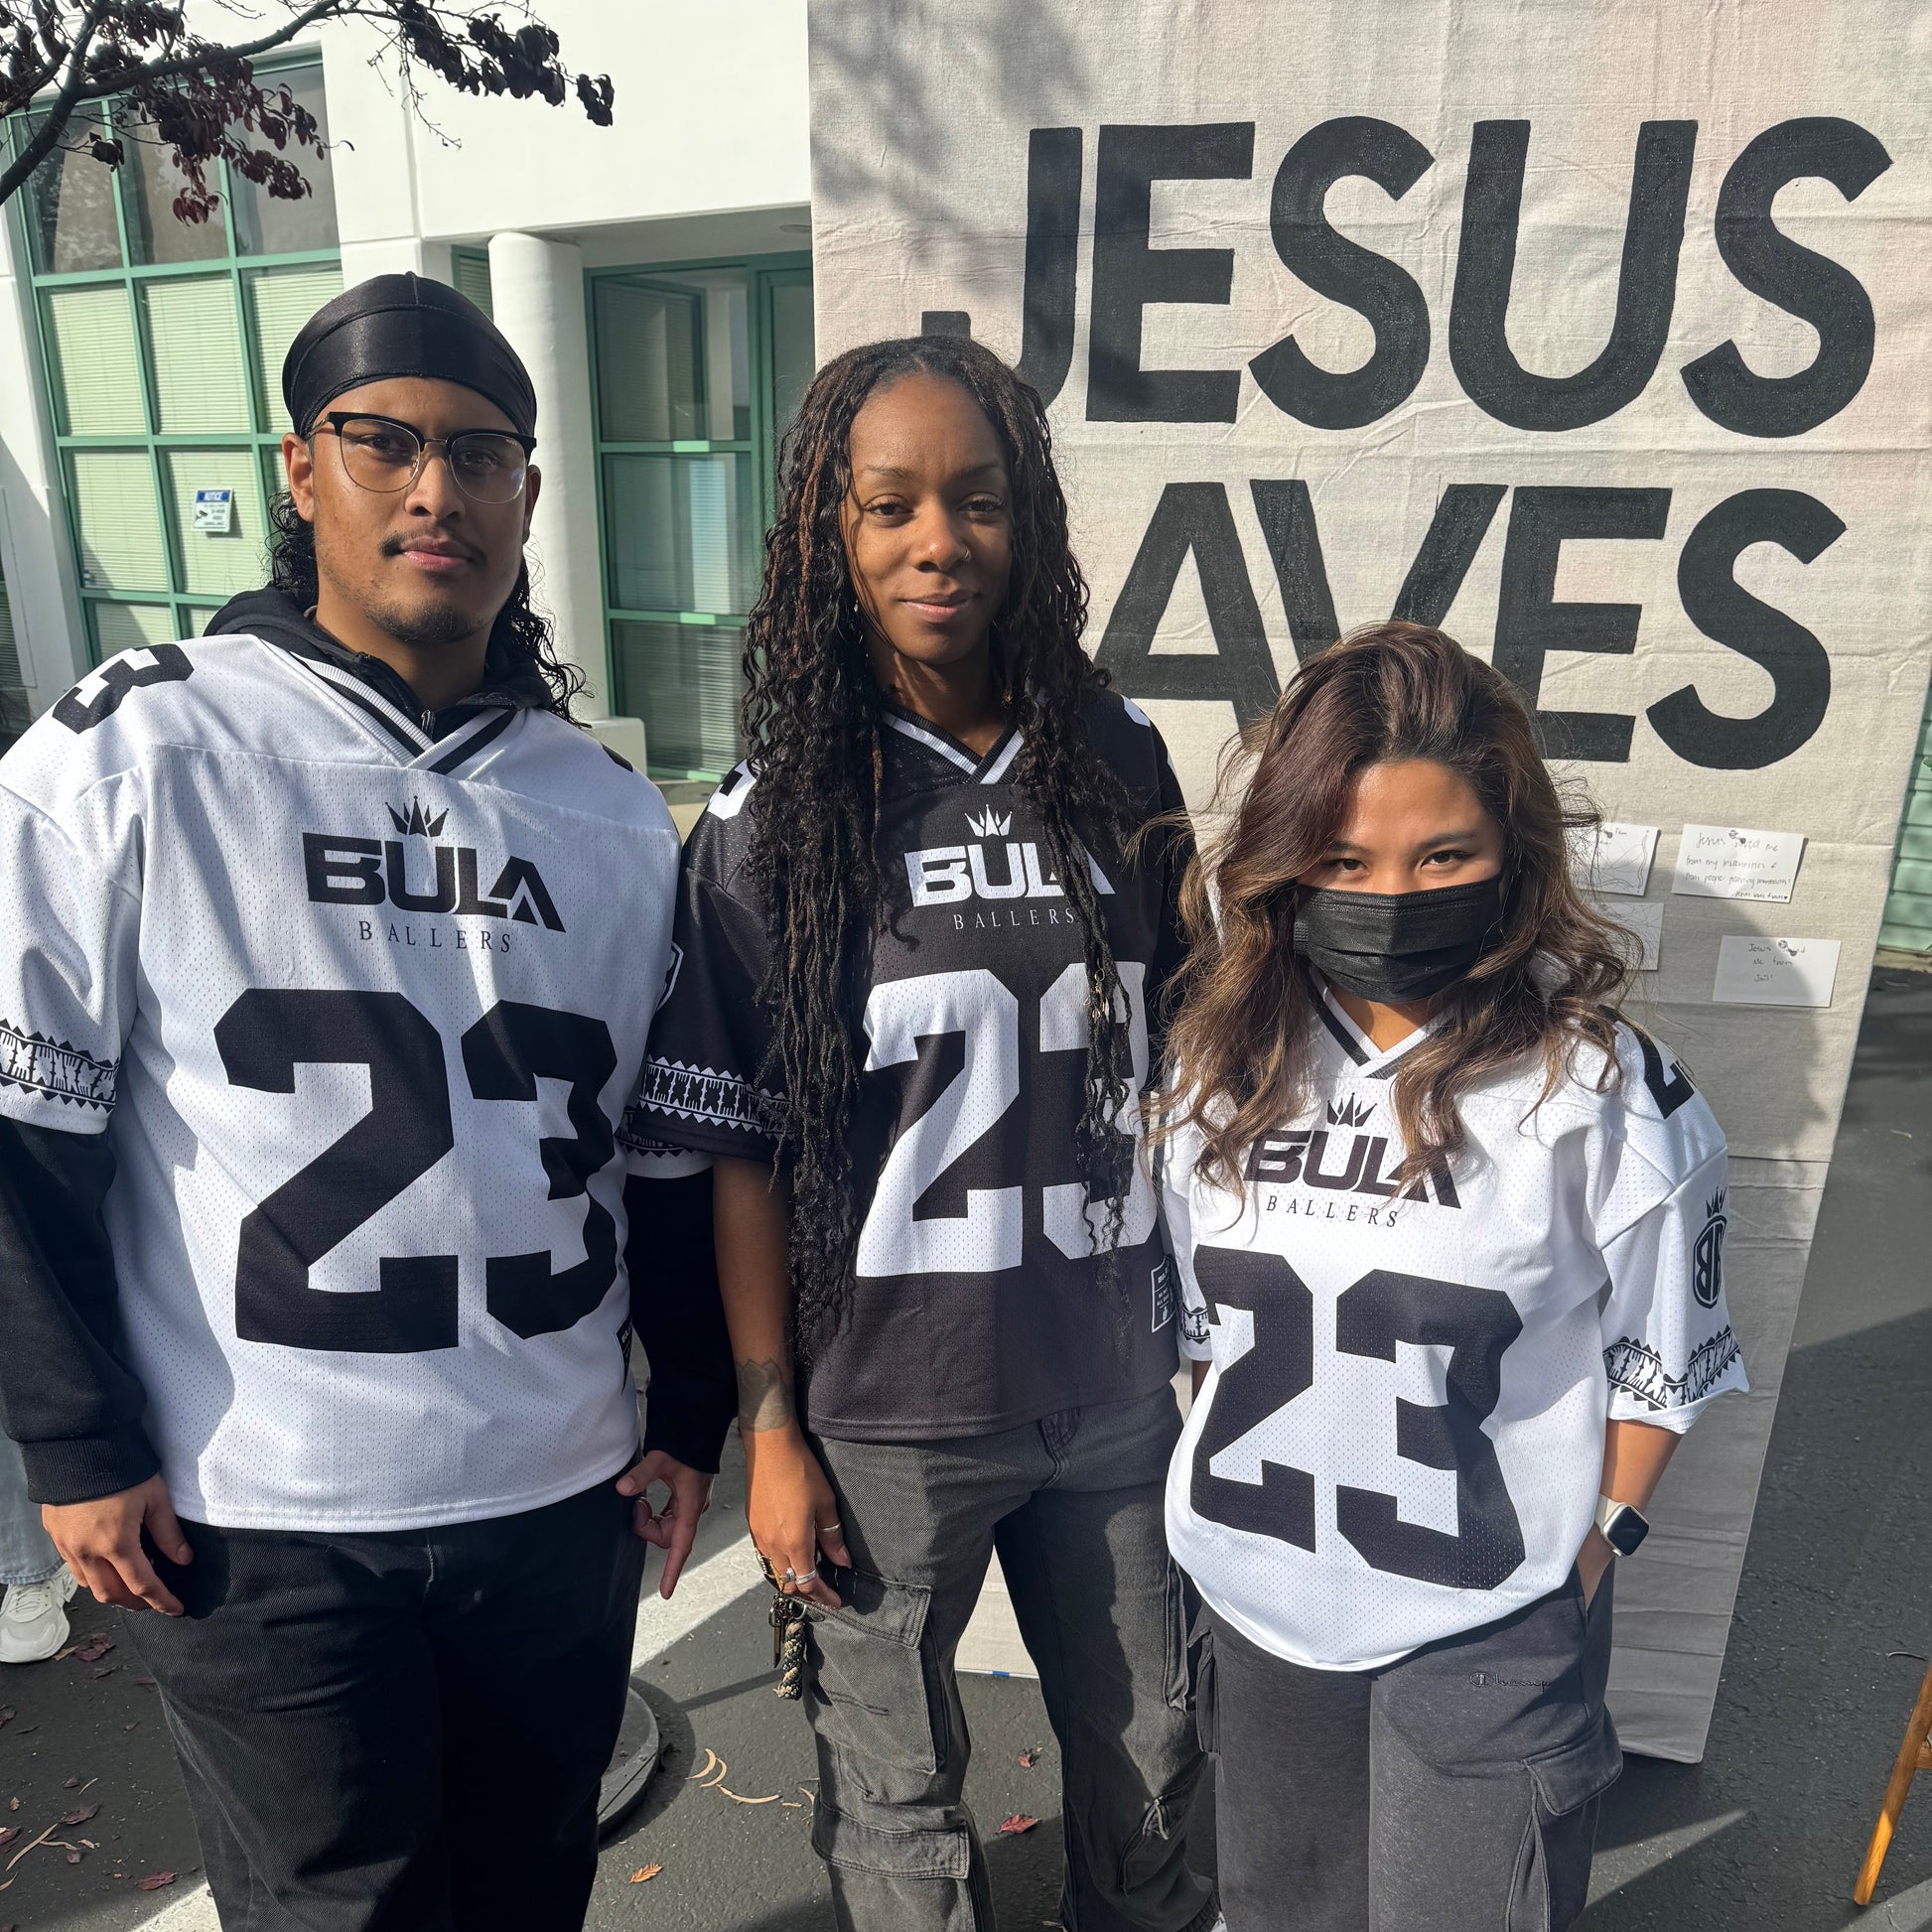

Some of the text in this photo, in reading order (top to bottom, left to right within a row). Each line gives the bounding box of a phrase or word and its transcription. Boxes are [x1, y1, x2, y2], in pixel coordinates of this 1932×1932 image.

[921, 116, 1892, 437] JESUS
[1093, 480, 1847, 770] AVES
[302, 832, 567, 933] BULA
[358, 920, 511, 953] BALLERS
[953, 907, 1074, 930] BALLERS
[213, 988, 619, 1354] 23
[856, 960, 1158, 1278] 23
[1266, 1194, 1398, 1228] BALLERS
[1189, 1243, 1526, 1591] 23
[1469, 1671, 1552, 1694] Champ
